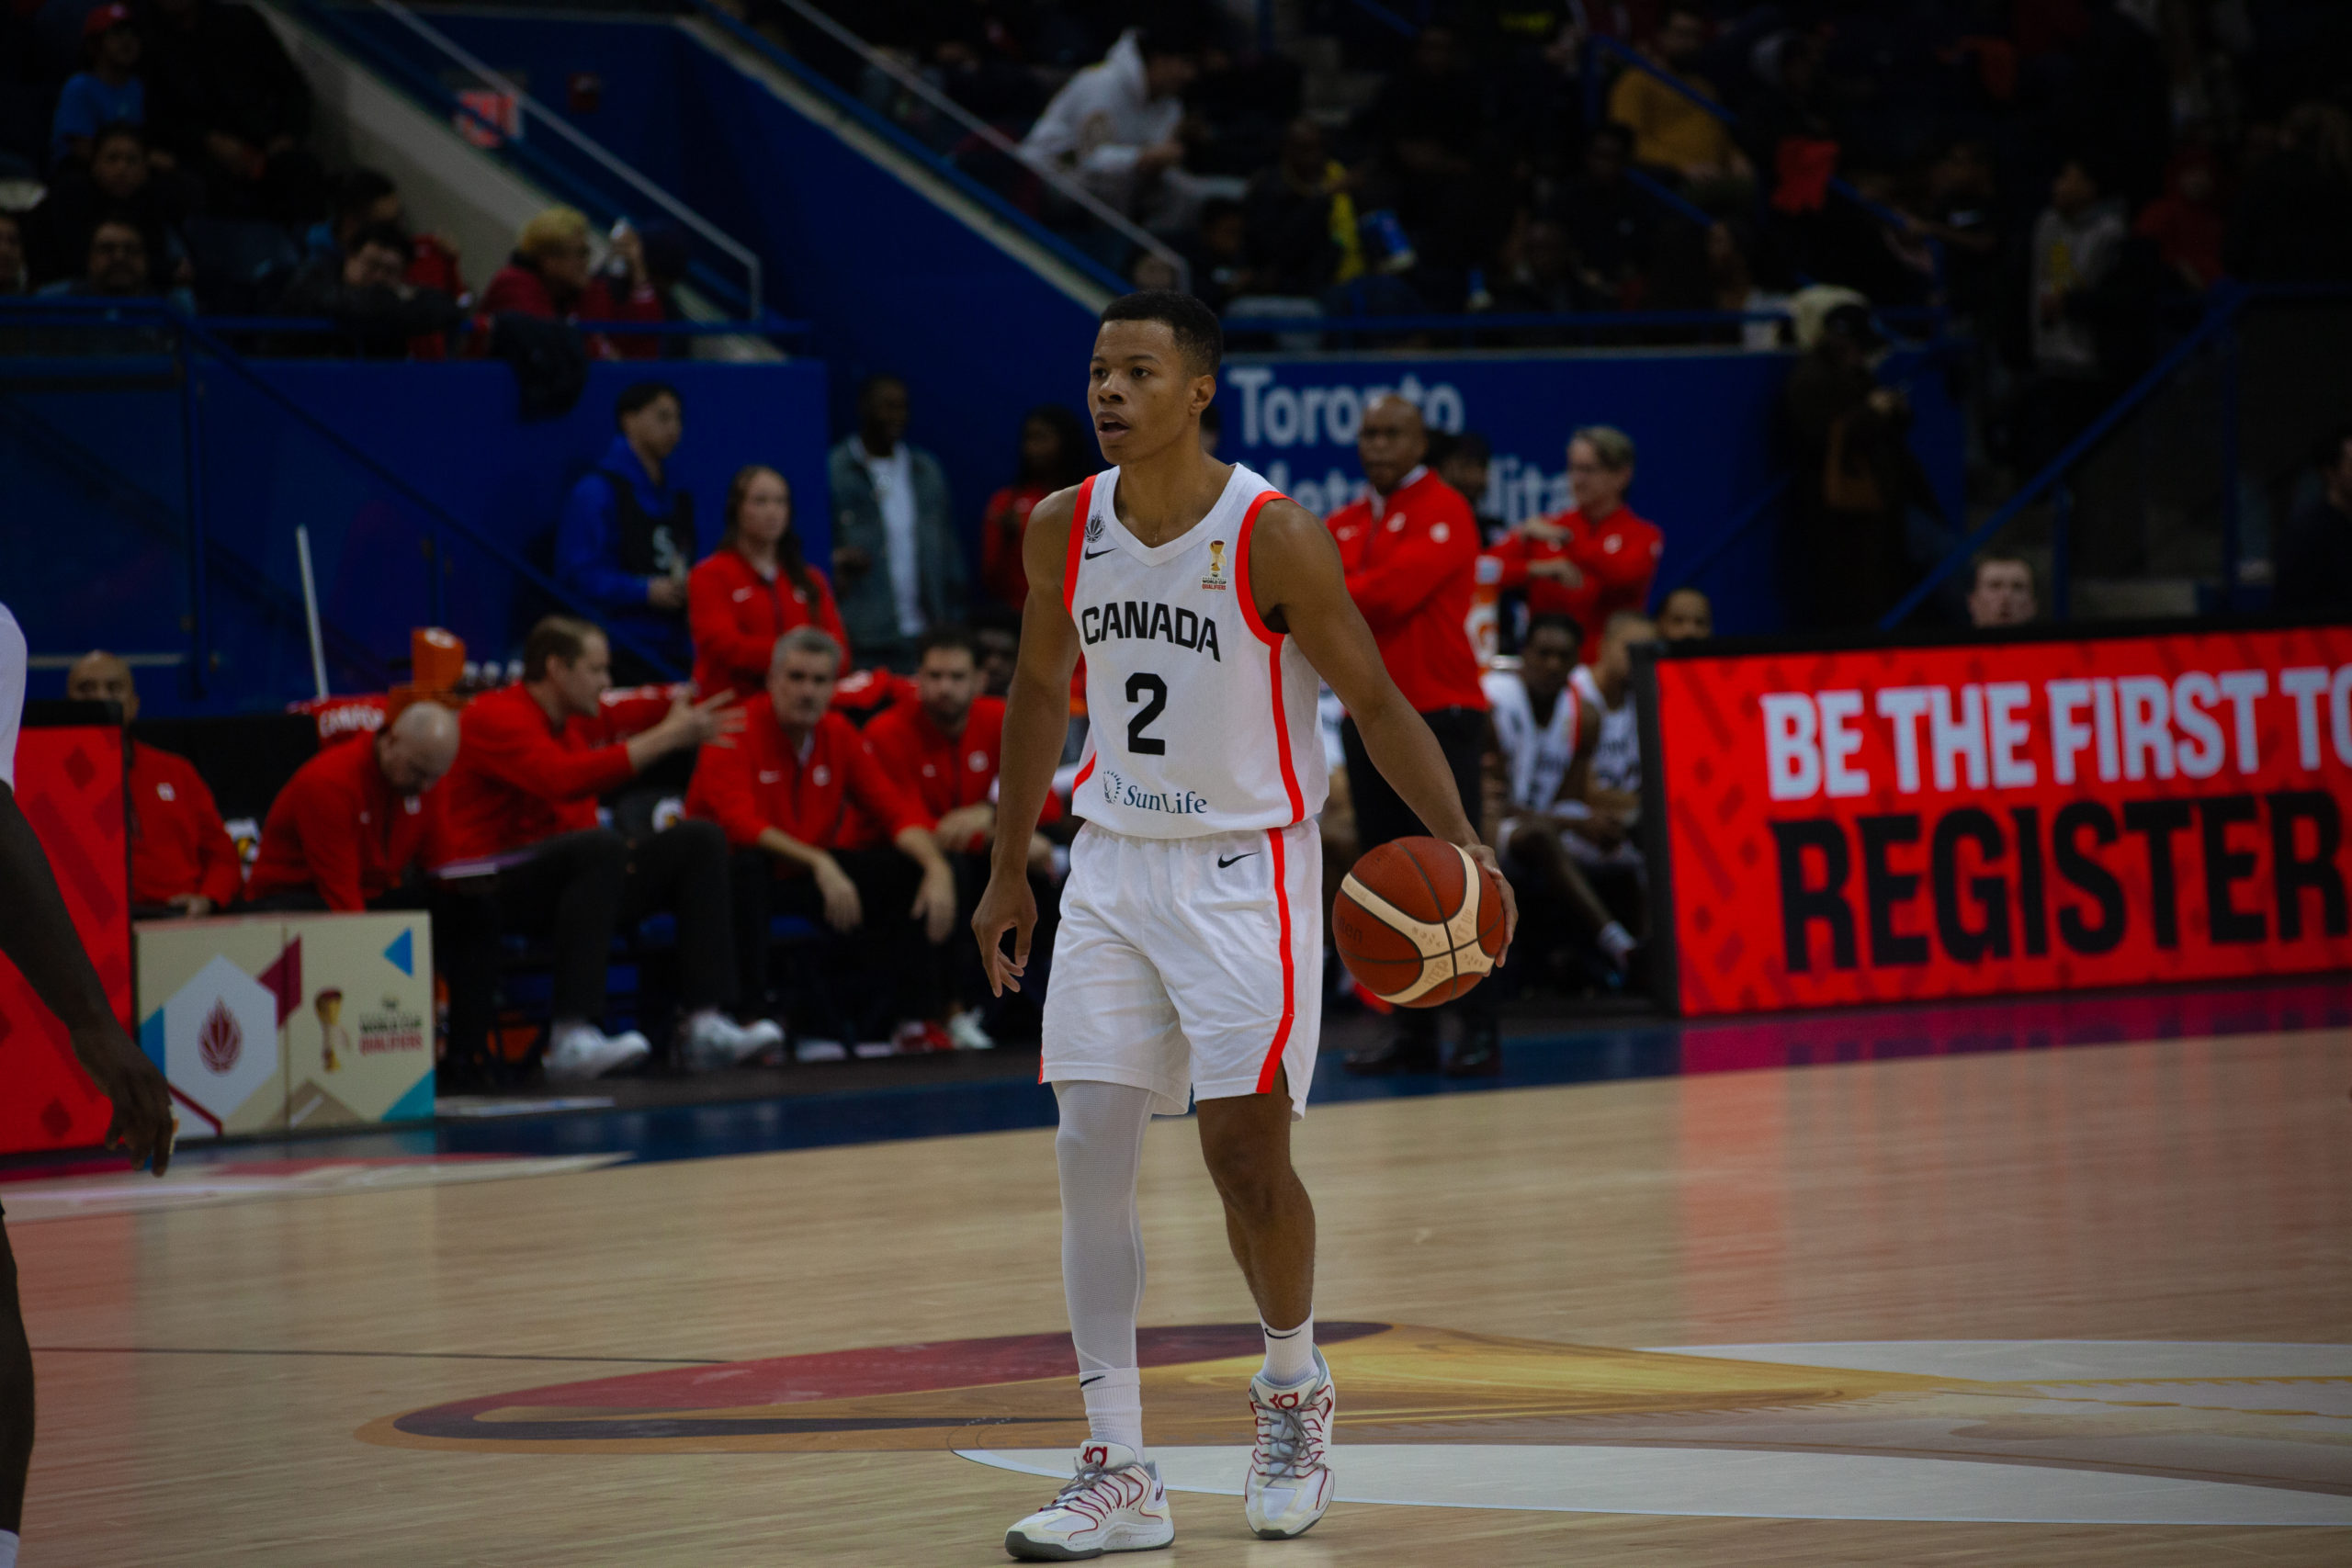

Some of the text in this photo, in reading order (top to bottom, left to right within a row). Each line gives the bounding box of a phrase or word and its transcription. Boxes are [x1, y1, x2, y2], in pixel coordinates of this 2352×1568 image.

[1226, 367, 1465, 448] Toroto
[1081, 601, 1221, 663] CANADA
[1125, 672, 1168, 756] 2
[1758, 688, 1871, 802] BE
[1876, 682, 2039, 794] THE
[2045, 671, 2269, 784] FIRST
[1772, 791, 2349, 971] REGISTER
